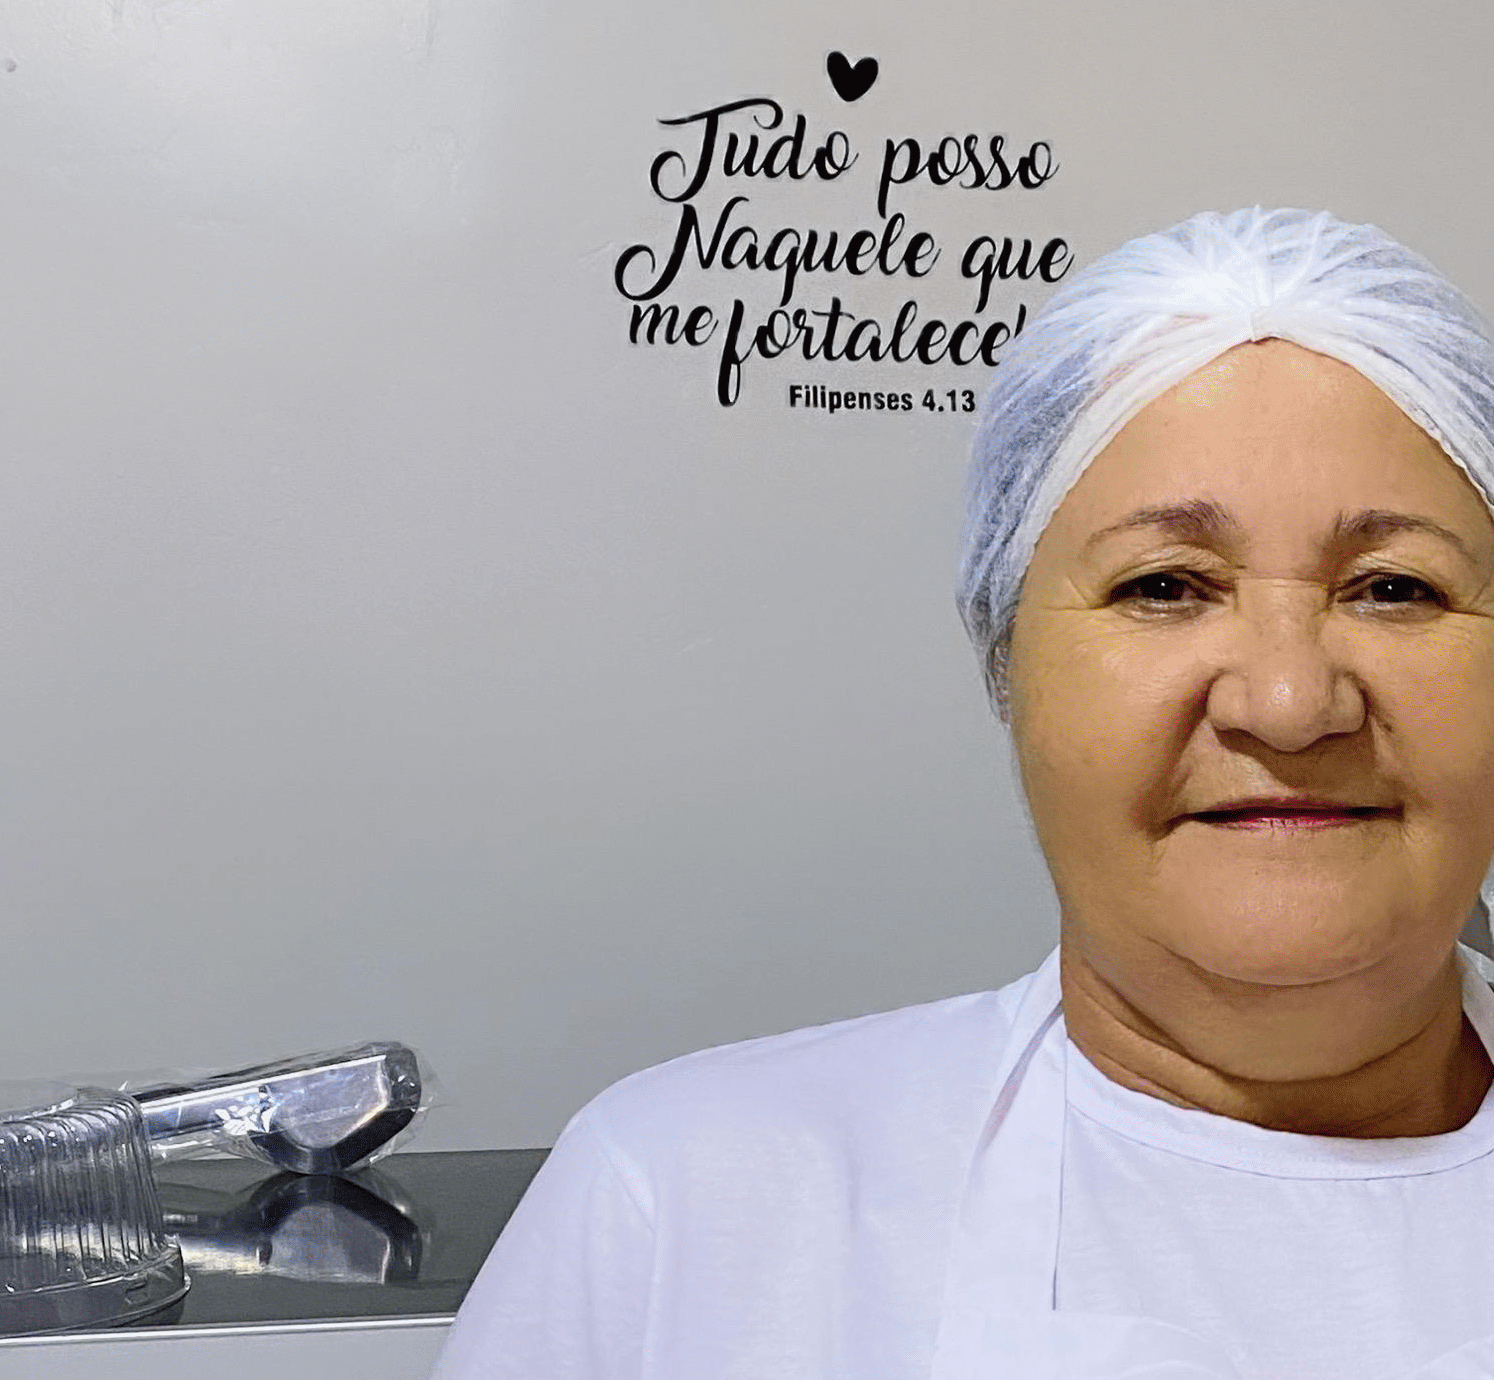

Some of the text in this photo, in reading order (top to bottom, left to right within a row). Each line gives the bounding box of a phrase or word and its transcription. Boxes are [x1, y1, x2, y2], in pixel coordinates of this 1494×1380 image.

[650, 98, 1060, 219] Tudo posso
[613, 196, 1076, 314] Naquele que
[628, 303, 719, 347] me
[788, 384, 976, 415] Filipenses 4.13
